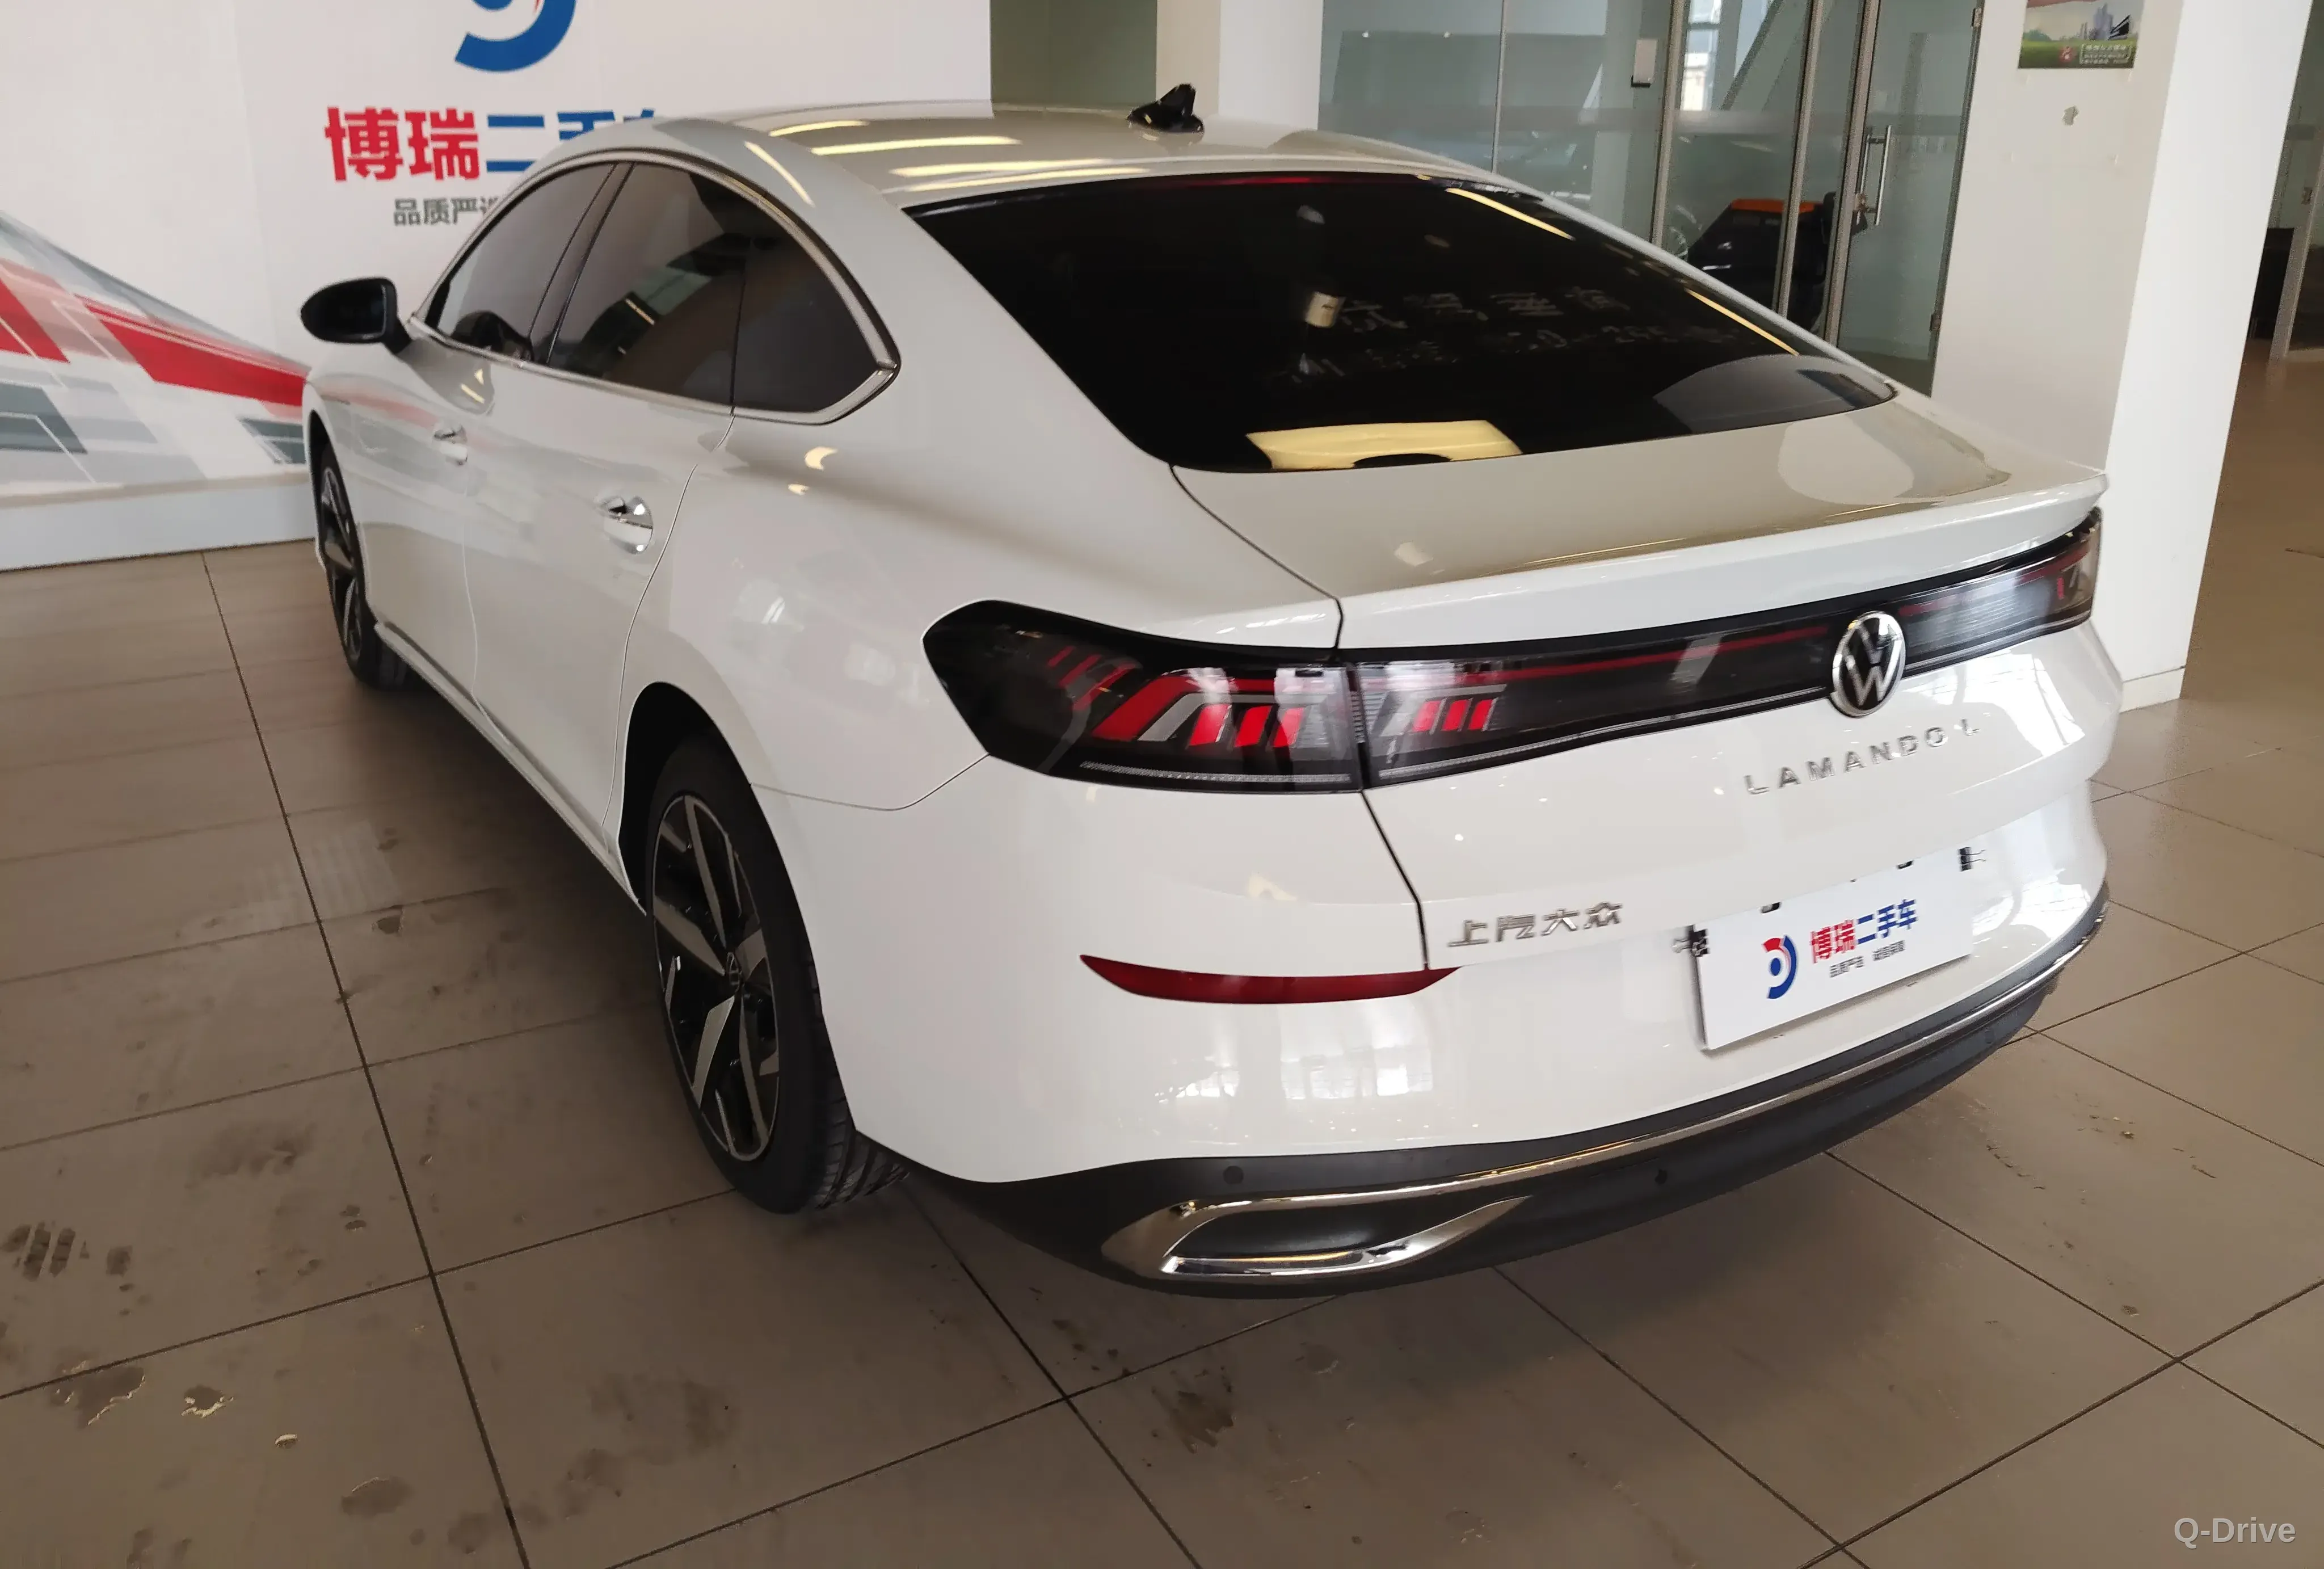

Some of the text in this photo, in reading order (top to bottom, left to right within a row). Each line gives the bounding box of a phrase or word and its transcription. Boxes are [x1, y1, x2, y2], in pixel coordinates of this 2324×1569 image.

[325, 106, 655, 182] 博瑞二
[1744, 718, 1980, 795] LAMANDO L
[1447, 901, 1622, 947] 上汽大众
[1810, 899, 1918, 964] 博瑞二手车
